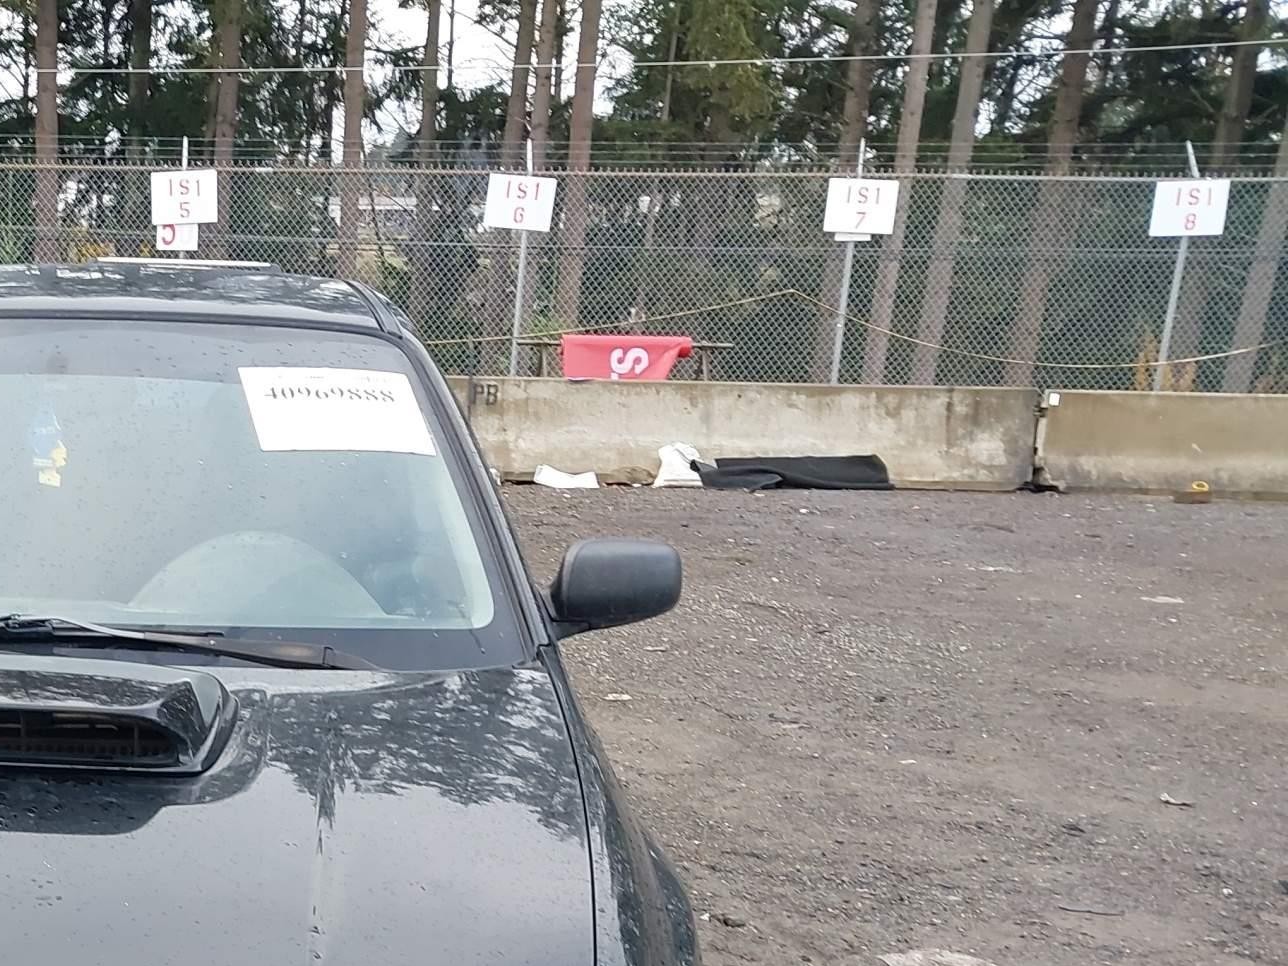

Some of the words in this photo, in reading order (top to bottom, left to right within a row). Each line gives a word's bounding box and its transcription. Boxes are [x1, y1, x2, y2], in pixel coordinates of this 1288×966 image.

[179, 201, 190, 218] 5
[513, 206, 525, 224] 6
[855, 211, 866, 229] 7
[1184, 213, 1197, 231] 8
